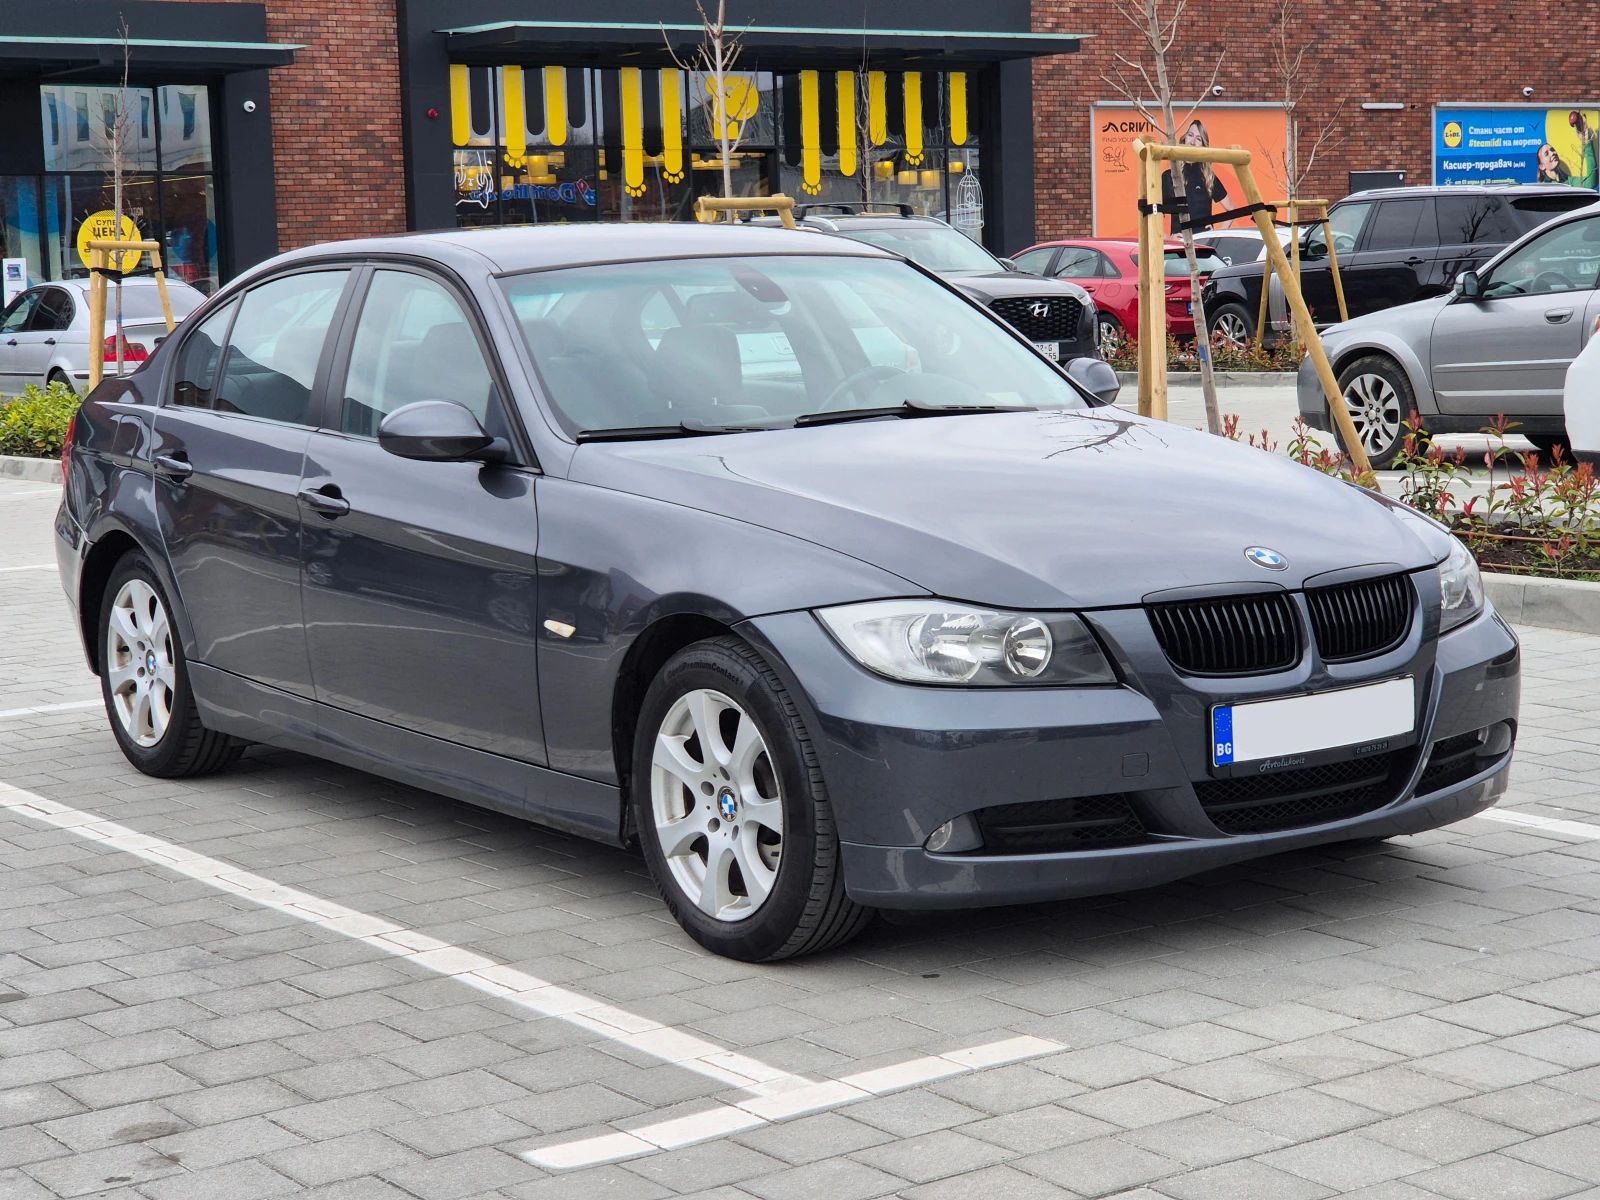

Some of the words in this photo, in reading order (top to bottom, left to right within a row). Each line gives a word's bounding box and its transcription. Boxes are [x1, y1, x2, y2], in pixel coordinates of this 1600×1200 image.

[1120, 122, 1155, 132] CRIVIT
[1468, 126, 1493, 135] Стани
[1494, 127, 1513, 135] част
[1468, 138, 1502, 147] #teamlidl
[1513, 139, 1542, 148] морето
[1443, 158, 1512, 171] Касиер-продавач
[93, 227, 126, 238] ЦЕНА
[1216, 742, 1232, 757] BG
